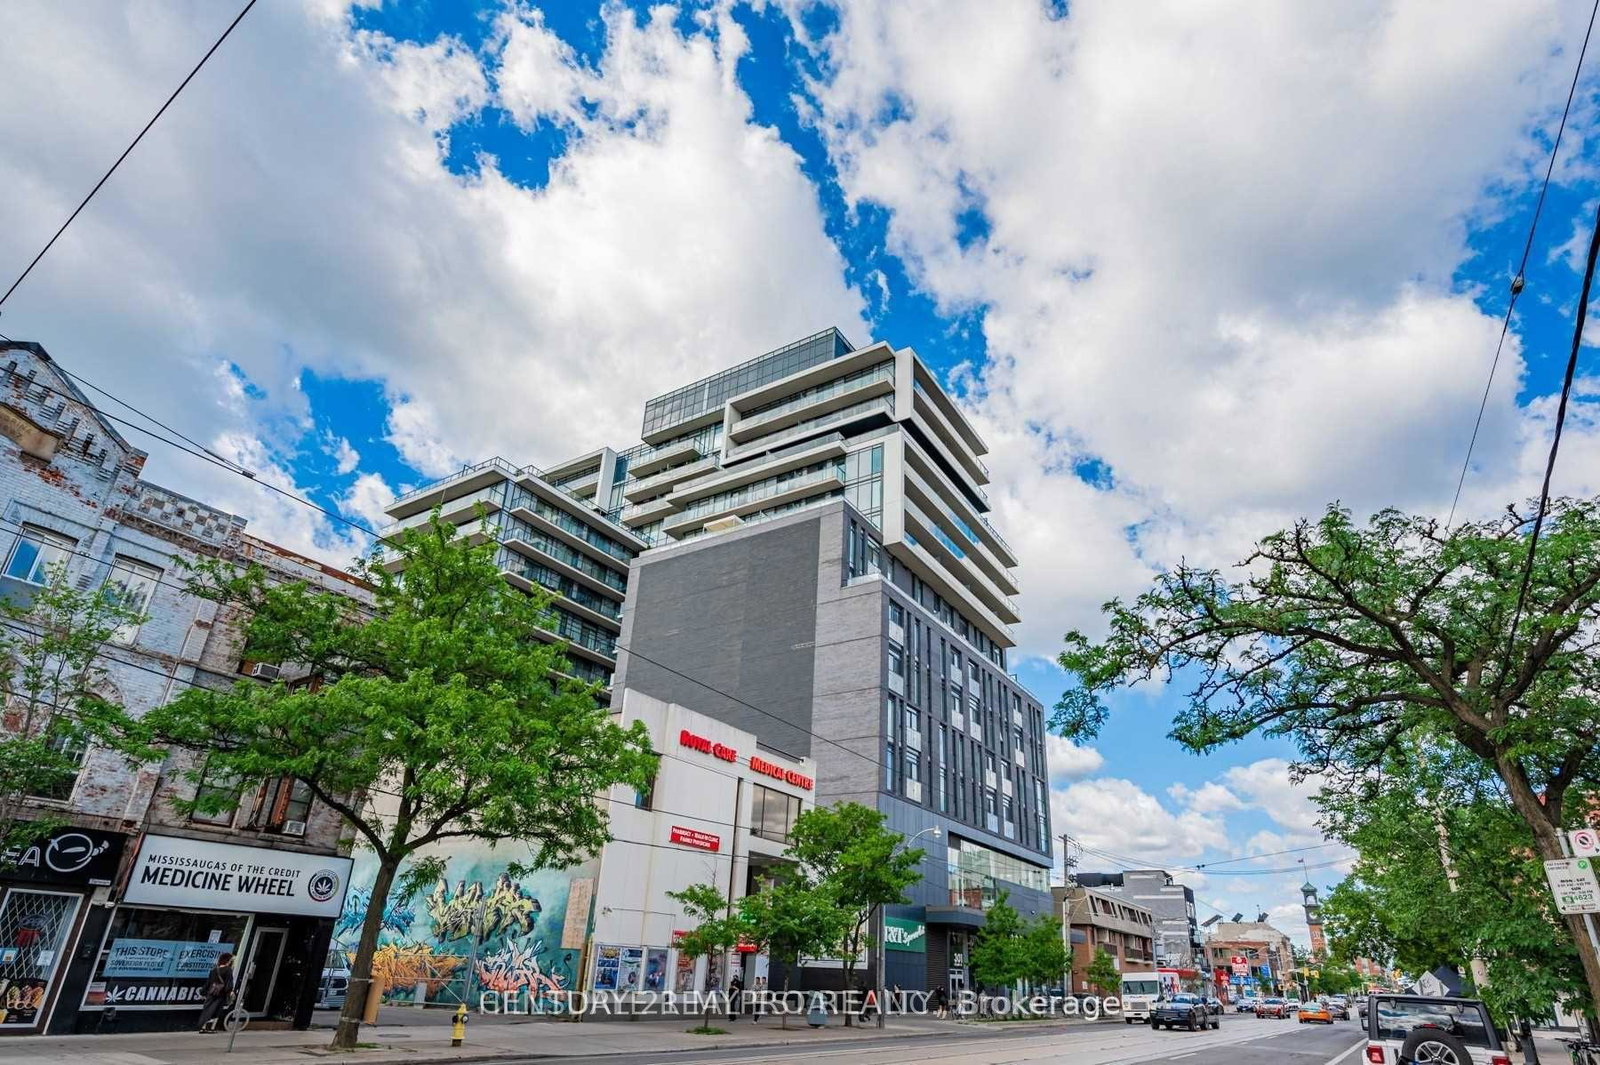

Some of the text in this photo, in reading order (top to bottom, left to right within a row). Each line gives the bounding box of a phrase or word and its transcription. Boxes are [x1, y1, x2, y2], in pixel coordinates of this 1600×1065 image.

[713, 743, 737, 763] CARE
[750, 756, 814, 791] MEDICAL CENTRE
[148, 854, 301, 879] MISSISSAUGAS OF THE CREDIT
[140, 865, 234, 892] MEDICINE
[237, 875, 296, 897] WHEEL
[115, 946, 138, 957] THIS
[124, 986, 204, 1001] CANNABIS
